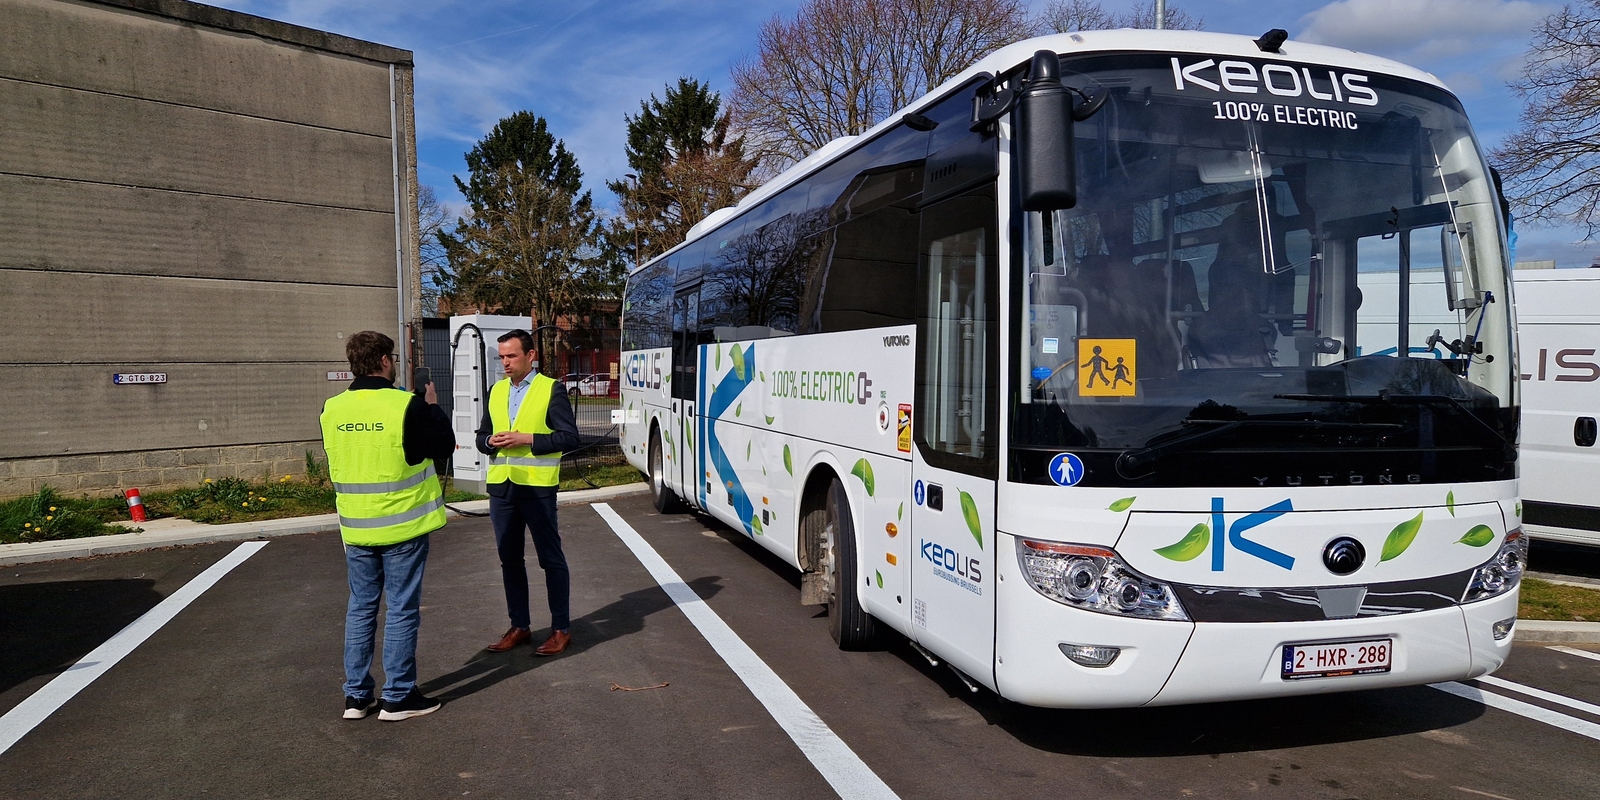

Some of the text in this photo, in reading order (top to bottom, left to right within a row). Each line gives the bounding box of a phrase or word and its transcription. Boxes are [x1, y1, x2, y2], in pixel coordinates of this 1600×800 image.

[1212, 101, 1358, 130] 100% ELECTRIC
[882, 335, 910, 347] YUTONG
[771, 370, 855, 404] 100% ELECTRIC
[1253, 473, 1421, 486] YUTONG
[959, 578, 982, 596] BRUSSELS
